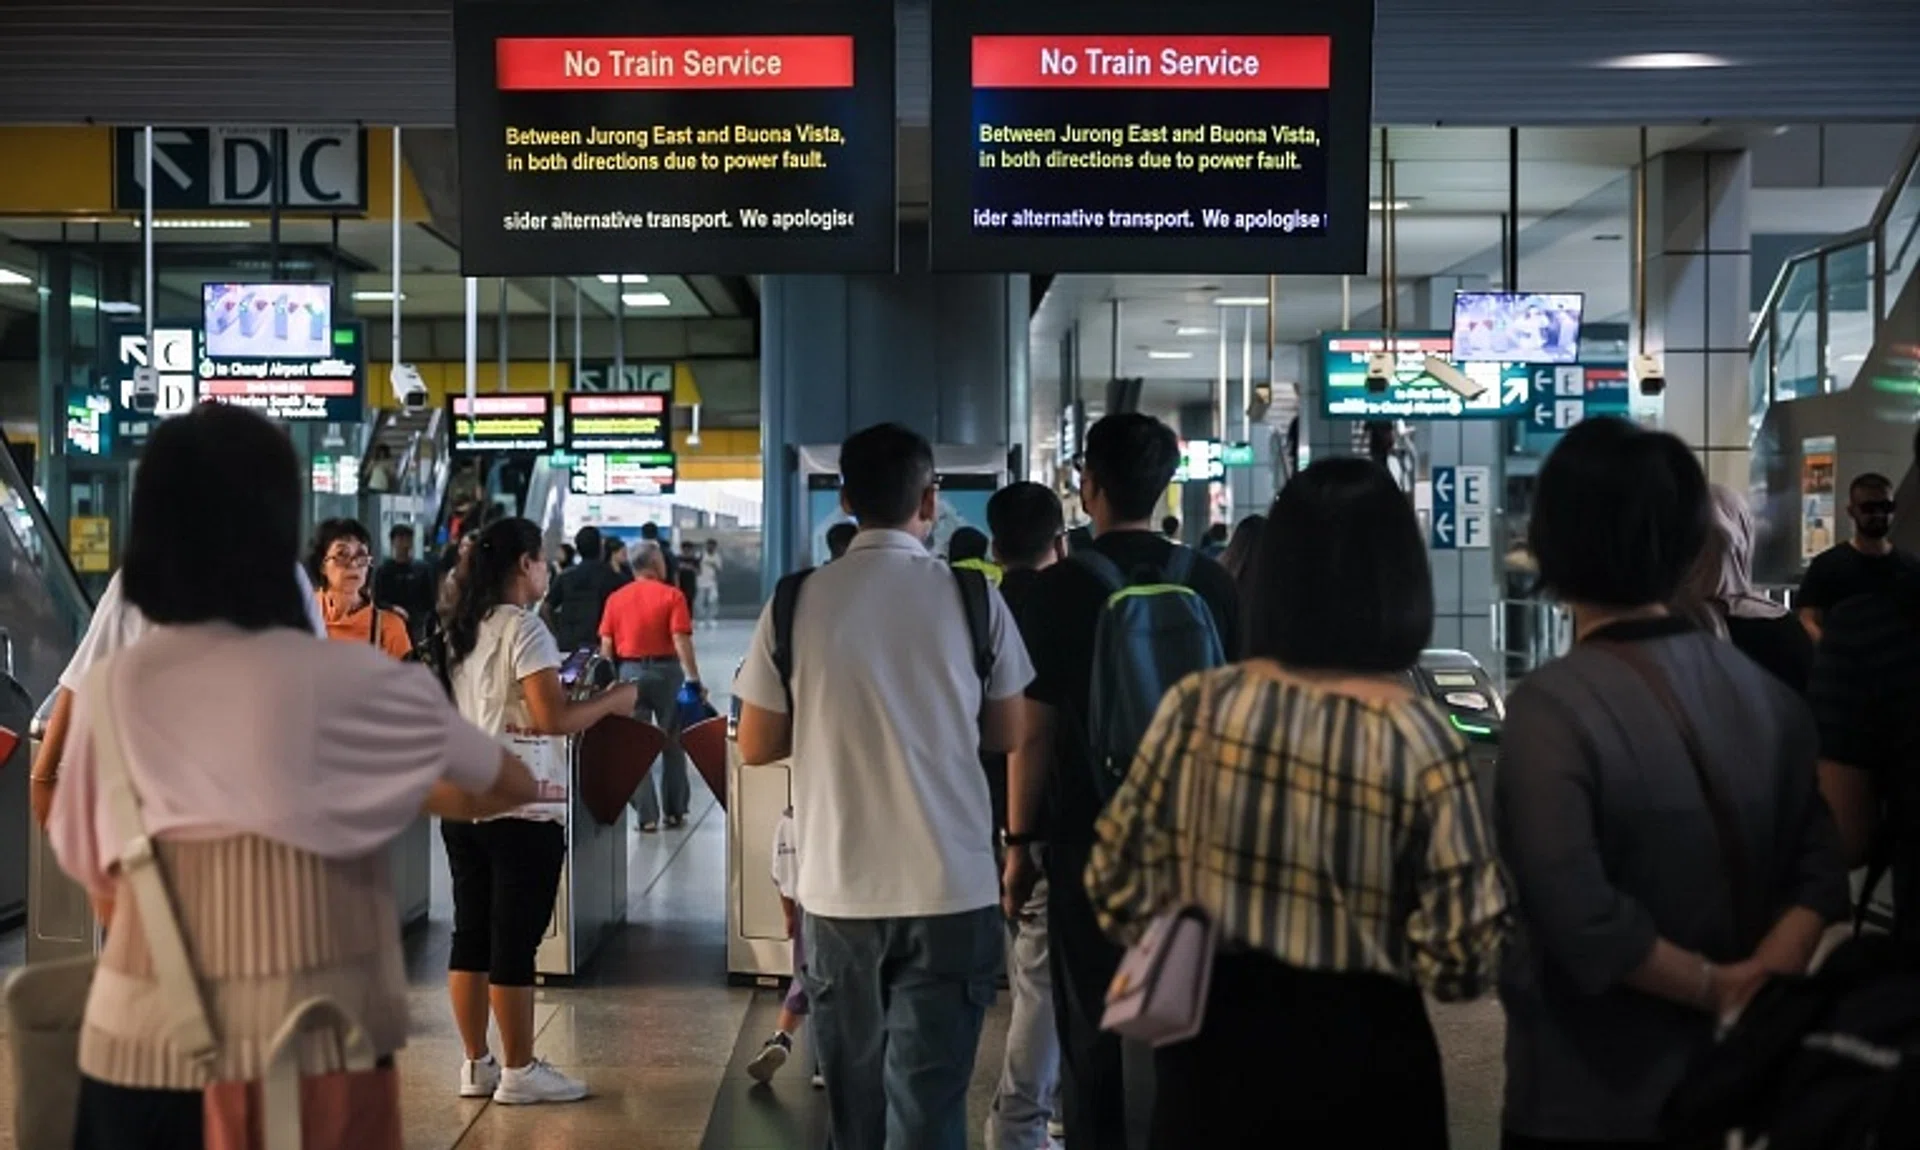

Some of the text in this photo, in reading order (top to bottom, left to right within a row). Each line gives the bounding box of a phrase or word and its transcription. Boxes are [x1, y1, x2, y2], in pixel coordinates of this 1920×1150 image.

[564, 49, 782, 77] No Train Service
[1041, 48, 1260, 76] No Train Service
[505, 123, 846, 150] Between Jurong East and Buona Vista,
[979, 123, 1321, 148] Between Jurong East and Buona Vista,
[223, 137, 342, 202] D C
[506, 149, 827, 174] in both directions due to power fault.
[979, 149, 1303, 173] in both directions due to power fault.
[503, 211, 548, 231] sider
[551, 210, 643, 230] alternative
[646, 210, 733, 233] transport.
[739, 208, 769, 228] We
[1011, 208, 1105, 228] alternative
[1107, 209, 1195, 232] transport.
[1201, 208, 1230, 228] We
[1234, 208, 1320, 233] apologise
[163, 340, 180, 366] C
[165, 385, 184, 410] D
[1465, 476, 1479, 504] E
[1465, 517, 1480, 545] F
